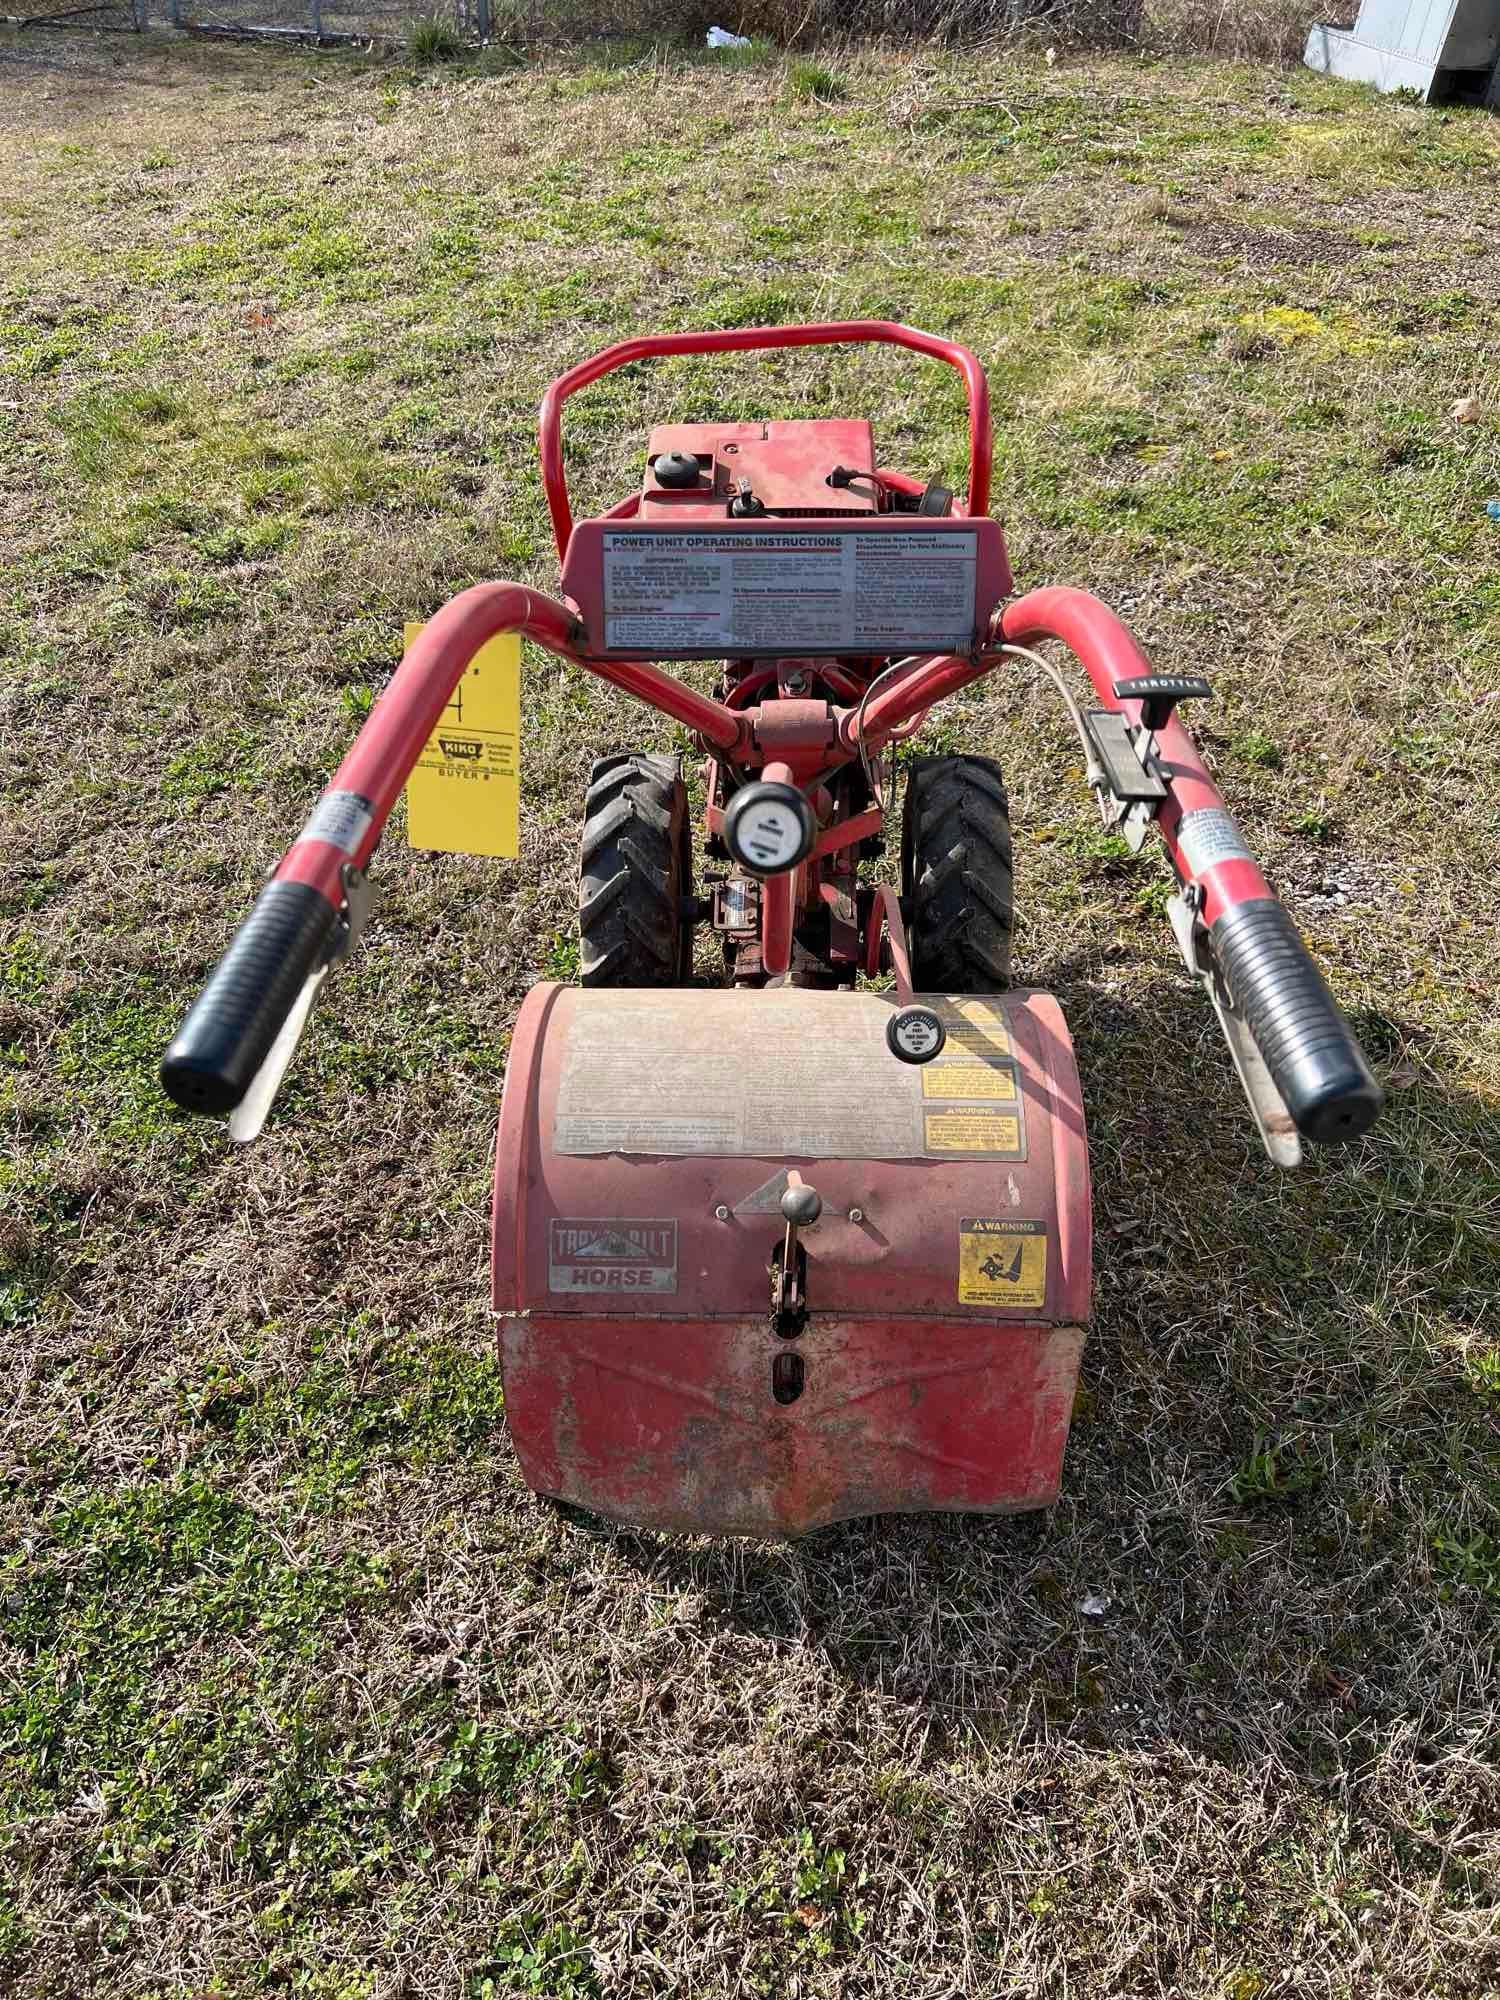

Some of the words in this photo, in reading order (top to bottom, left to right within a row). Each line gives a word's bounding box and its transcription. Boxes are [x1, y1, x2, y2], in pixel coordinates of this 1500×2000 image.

[612, 537, 654, 547] POWER
[656, 537, 684, 547] UNIT
[686, 537, 753, 547] OPERATING
[755, 537, 843, 547] INSTRUCTIONS
[1129, 678, 1201, 690] THROTTLE
[444, 742, 477, 755] KIKO
[438, 768, 479, 781] BUYER
[985, 1222, 1036, 1232] WARNING
[571, 1269, 654, 1287] HORSE
